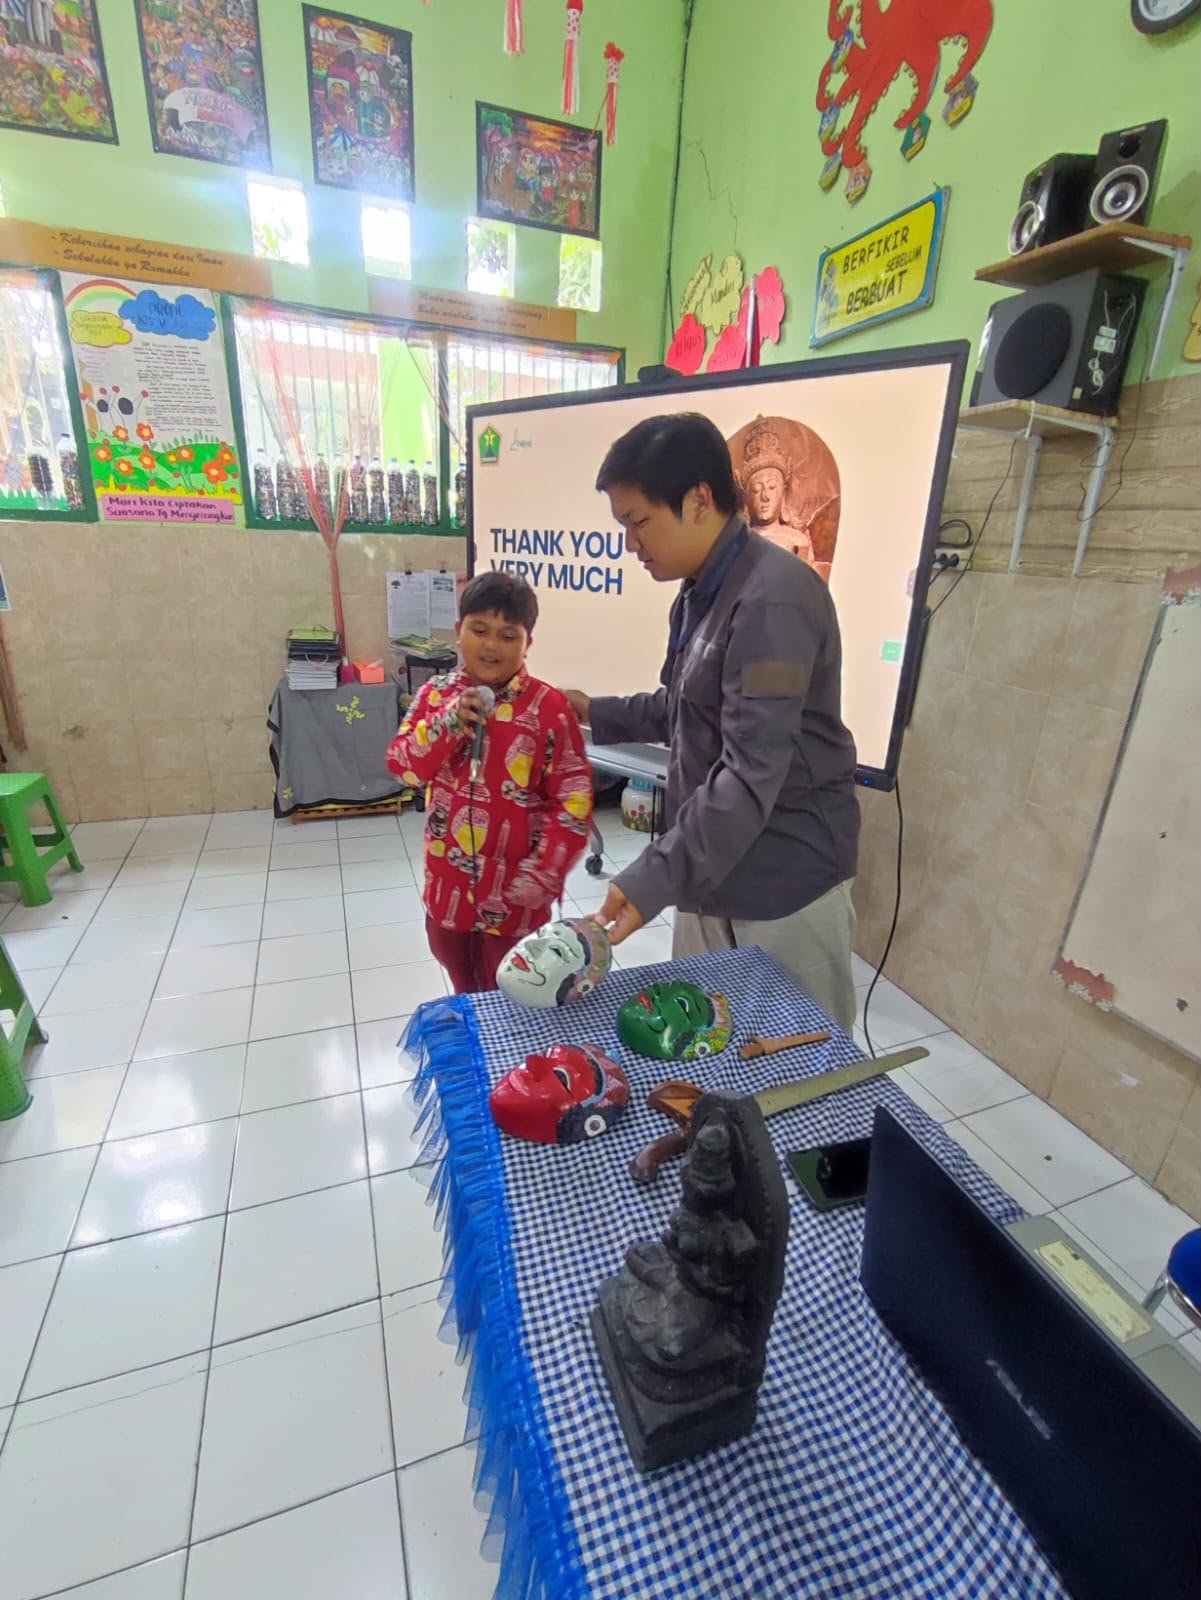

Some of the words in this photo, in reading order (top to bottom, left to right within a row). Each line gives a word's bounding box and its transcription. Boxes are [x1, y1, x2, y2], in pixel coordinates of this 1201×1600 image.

[842, 225, 910, 274] BERFIKIR
[885, 245, 923, 274] SEBELUM
[845, 269, 908, 315] BERBUAT
[490, 528, 565, 557] THANK
[569, 530, 624, 560] YOU
[547, 563, 623, 596] MUCH
